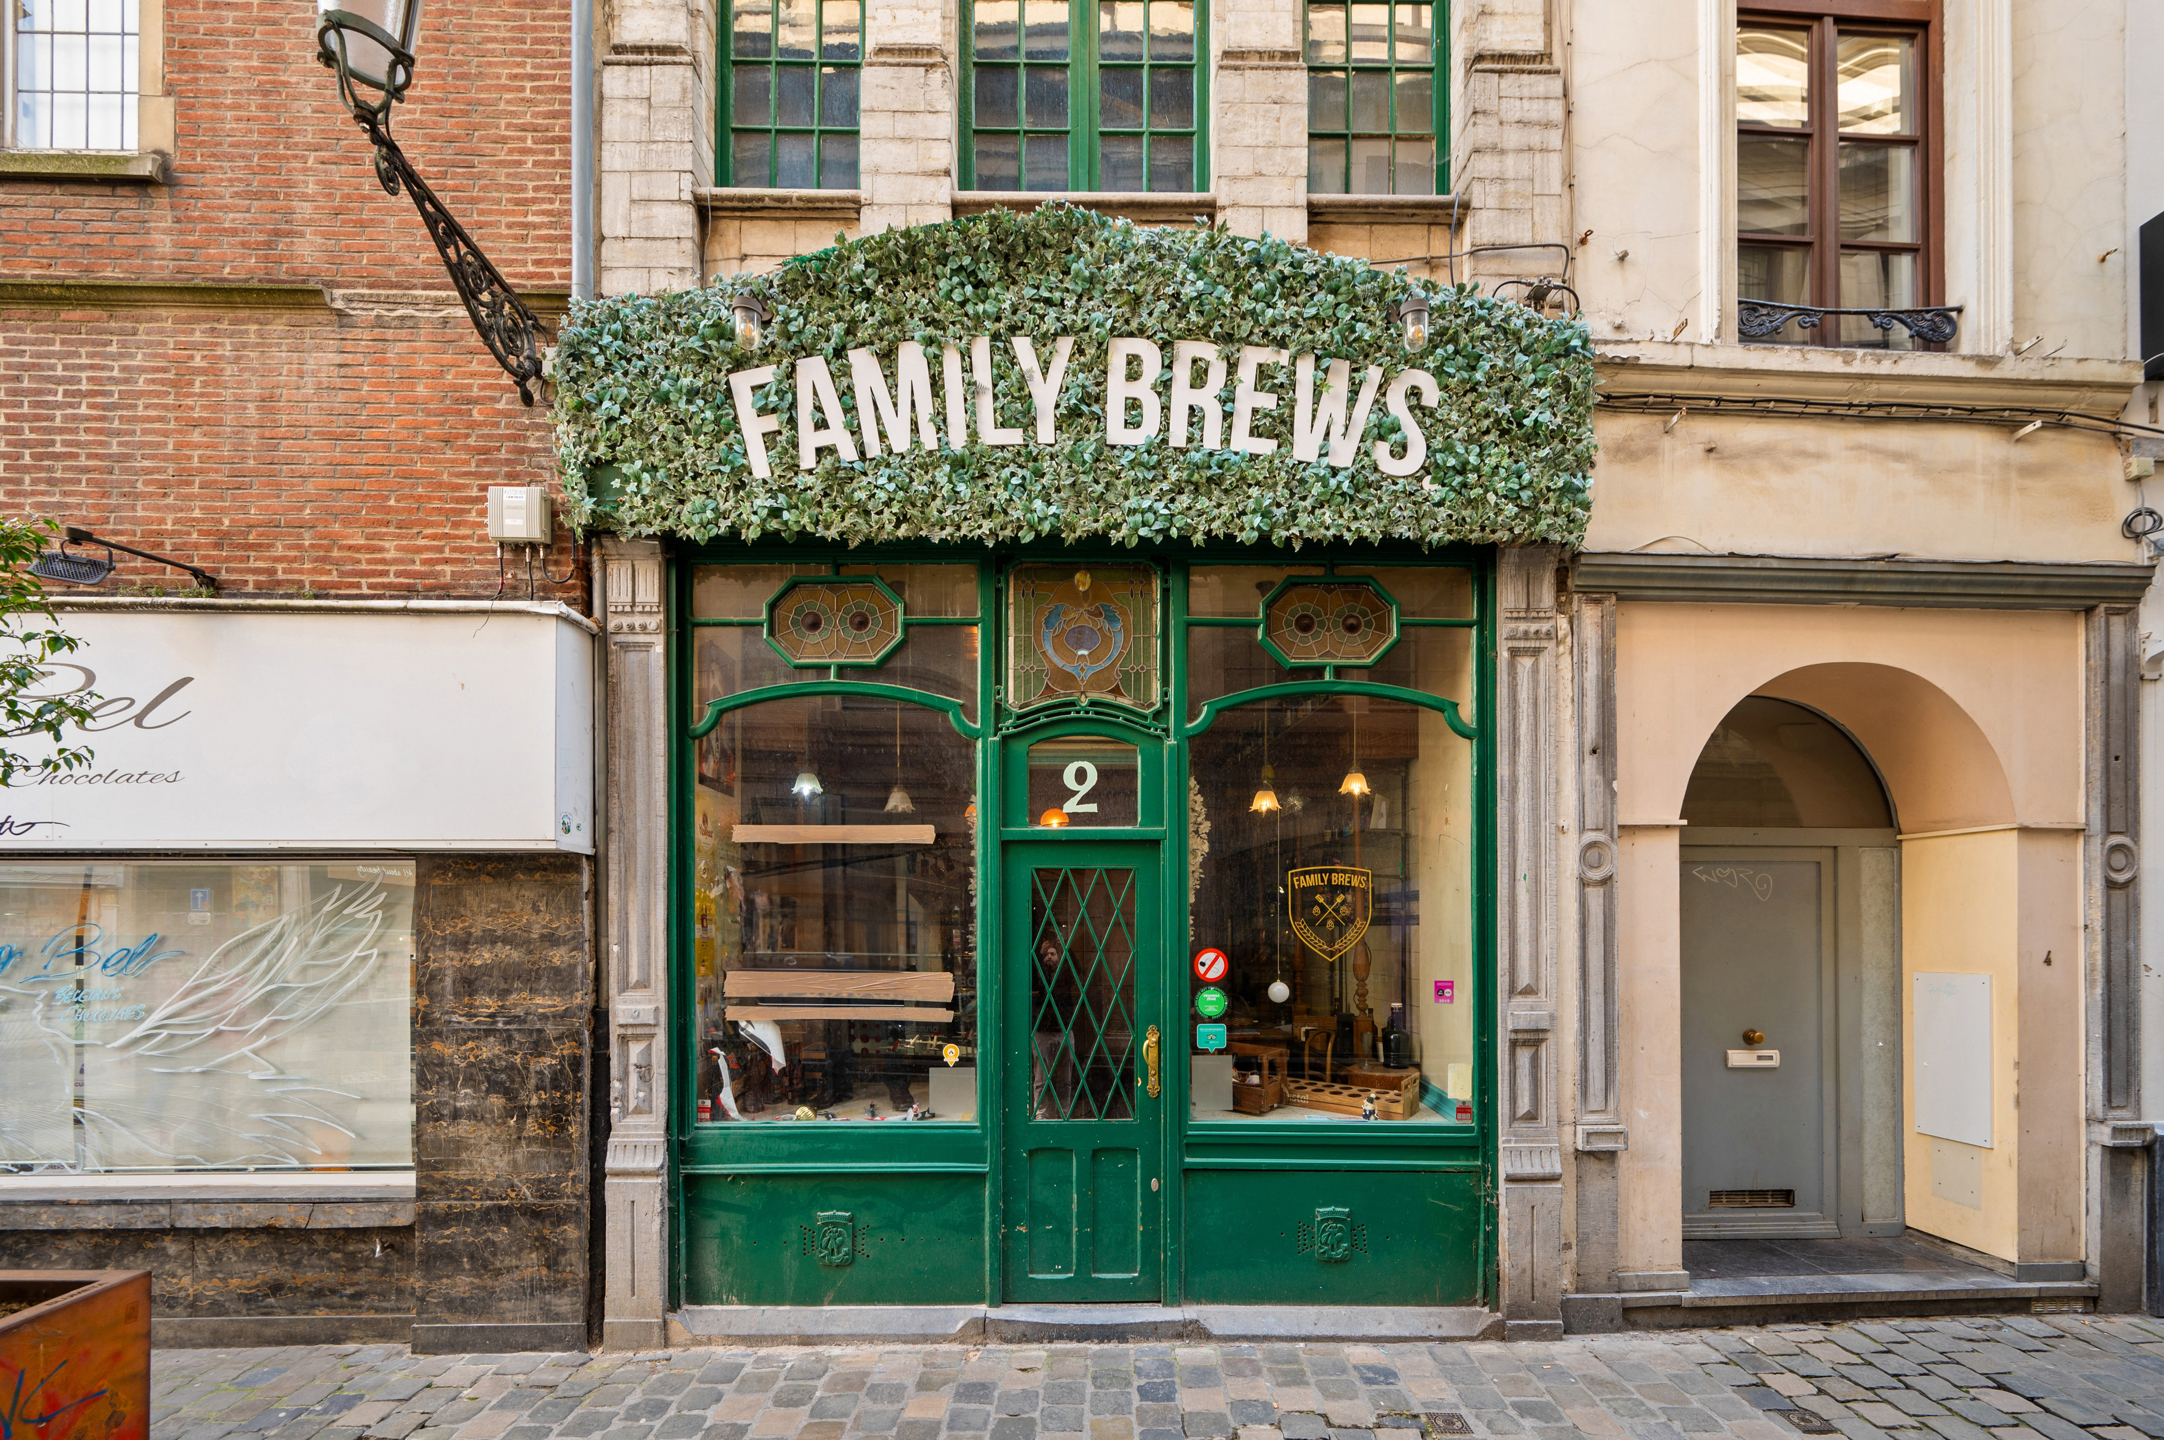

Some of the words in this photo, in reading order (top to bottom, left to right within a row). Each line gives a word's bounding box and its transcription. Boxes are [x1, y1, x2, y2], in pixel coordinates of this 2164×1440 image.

[729, 336, 1075, 478] FAMILY
[1105, 337, 1440, 476] BREWS
[7, 768, 186, 788] Chocolates
[1063, 761, 1098, 813] 2
[1293, 873, 1329, 889] FAMILY
[1331, 873, 1367, 889] BREWS
[19, 922, 186, 984] Bel
[2043, 950, 2053, 966] 4
